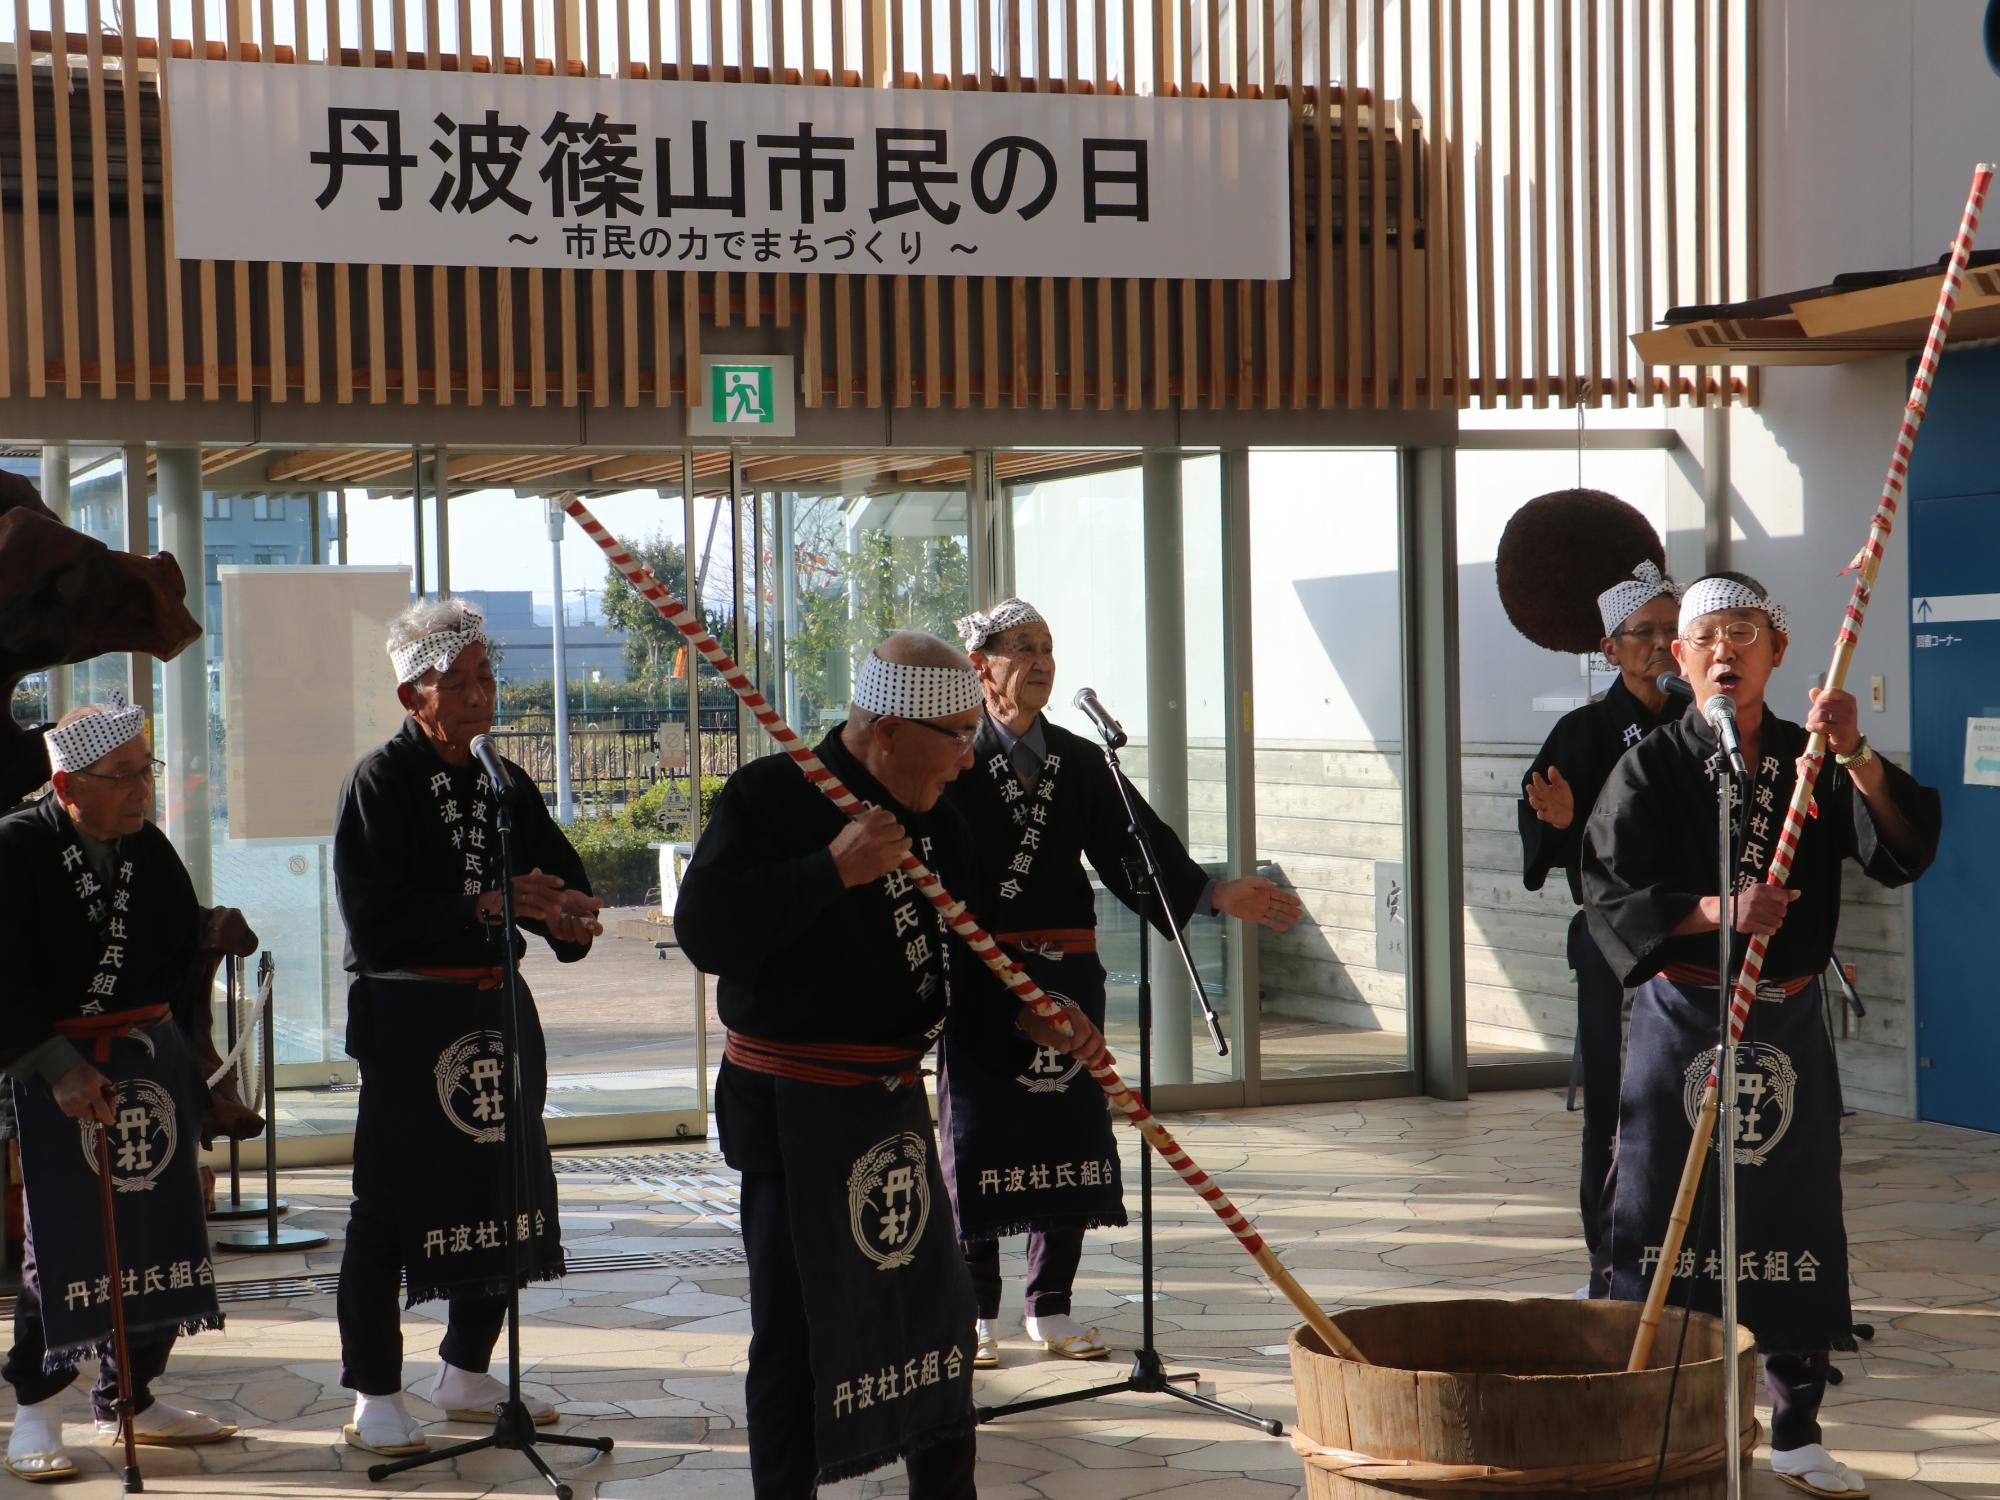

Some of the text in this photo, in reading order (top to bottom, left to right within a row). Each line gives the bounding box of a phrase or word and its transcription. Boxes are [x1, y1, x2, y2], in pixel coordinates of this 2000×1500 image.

[310, 107, 1149, 224] 丹波篠山市民の日
[562, 224, 922, 265] 市民の力でまちづくり
[999, 753, 1061, 900] 丹波杜氏組合
[978, 1158, 1113, 1196] 丹波杜氏組合
[423, 1209, 546, 1259] 丹波杜組合
[833, 1345, 963, 1419] 丹波杜氏組合
